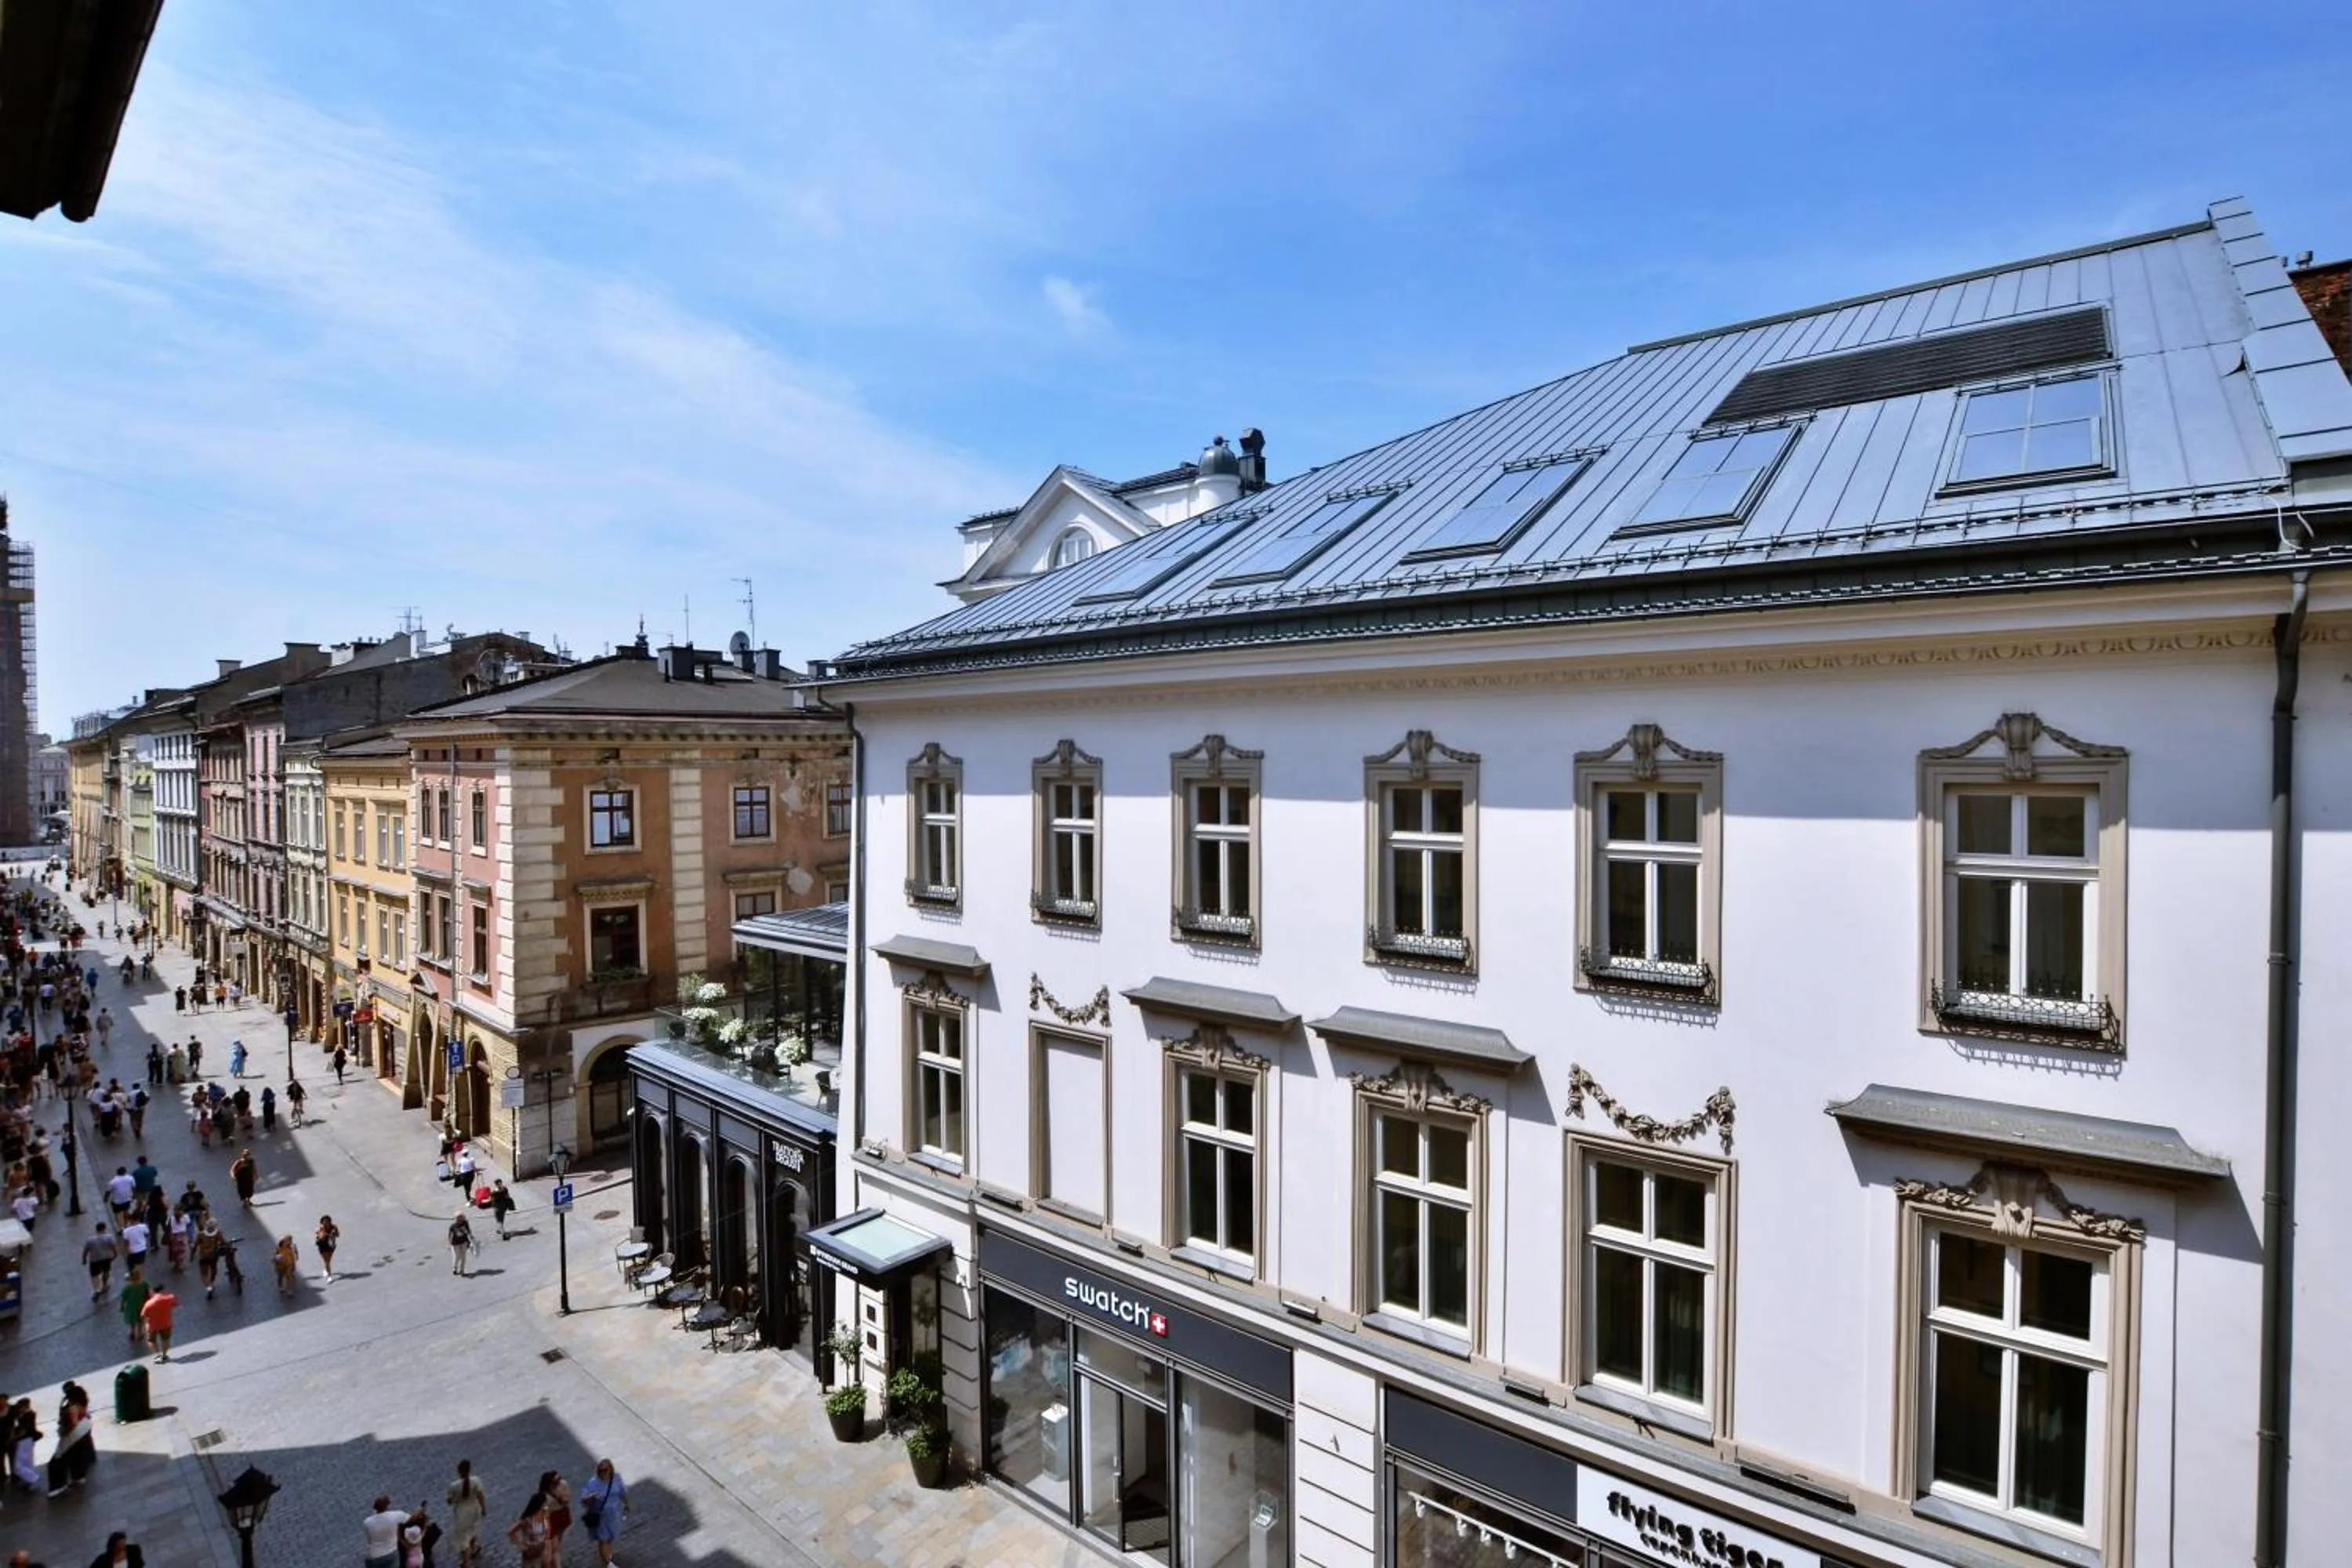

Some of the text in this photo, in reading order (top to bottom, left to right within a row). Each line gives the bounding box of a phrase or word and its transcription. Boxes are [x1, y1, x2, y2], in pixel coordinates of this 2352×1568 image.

[557, 1188, 568, 1203] P
[1065, 1277, 1149, 1330] swatch
[1607, 1491, 1696, 1550] flying
